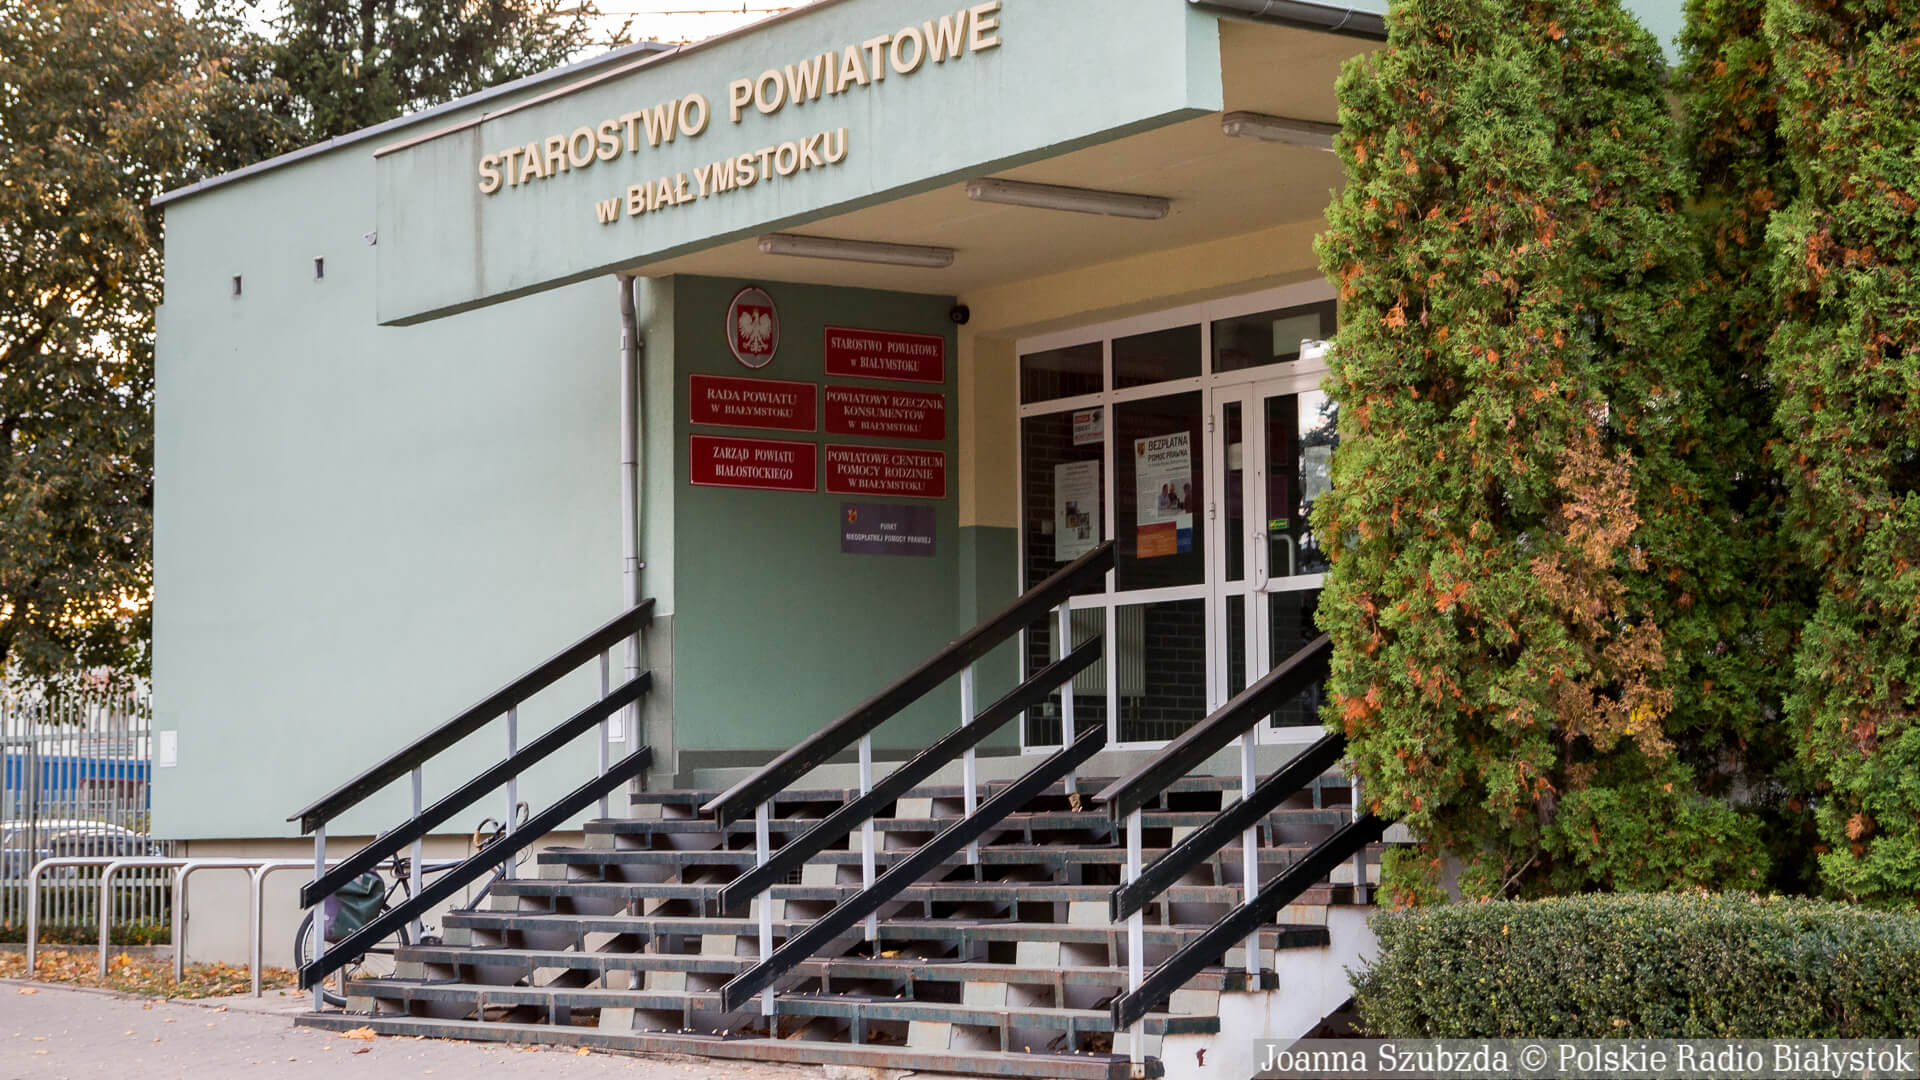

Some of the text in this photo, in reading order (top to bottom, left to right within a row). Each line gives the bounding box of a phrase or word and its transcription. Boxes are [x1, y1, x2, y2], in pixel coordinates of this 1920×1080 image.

[478, 0, 1001, 194] STAROSTWO POWIATOWE
[626, 128, 849, 216] BIAŁYMSTOKU
[831, 336, 939, 357] STAROSTWO POWIATOWE
[706, 388, 798, 405] RADA POWIATU
[826, 391, 944, 410] POWIATOWY RZECZNIK
[711, 403, 794, 418] W BIAŁYMSTOKU
[848, 420, 856, 430] W
[713, 446, 796, 464] ZARZĄD POWIATU
[828, 450, 943, 468] POWIATOWE CENTRUM
[715, 463, 793, 480] BIAŁOSTOCKIEGO
[837, 463, 933, 480] POMOCY RODZINIE
[848, 478, 857, 488] W
[880, 522, 897, 531] PUNKT
